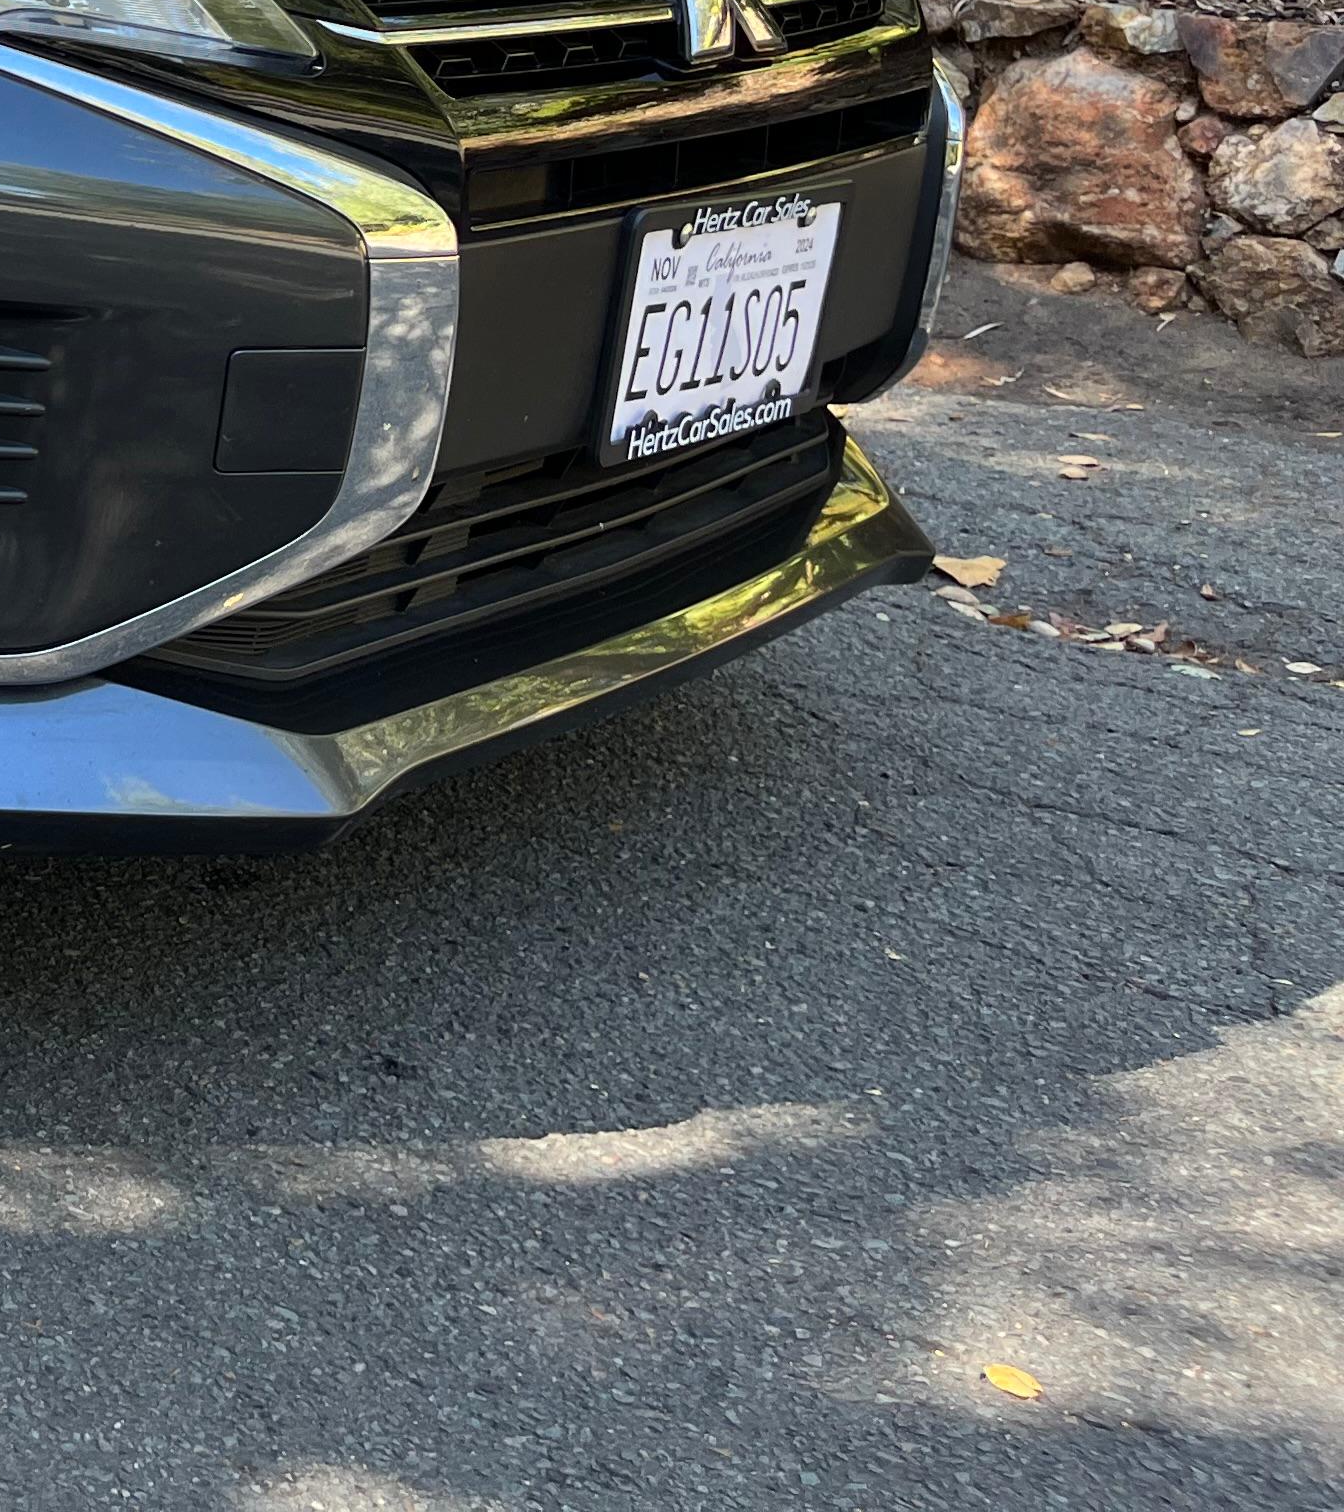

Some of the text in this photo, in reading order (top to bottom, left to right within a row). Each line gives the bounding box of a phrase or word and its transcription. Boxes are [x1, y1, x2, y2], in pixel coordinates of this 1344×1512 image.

[693, 193, 811, 235] Hertz Car Sales
[706, 242, 772, 283] California
[795, 237, 814, 254] 2024
[650, 255, 681, 282] NOV
[624, 280, 807, 402] EG11S05
[627, 397, 792, 460] HertzCarSales.com
